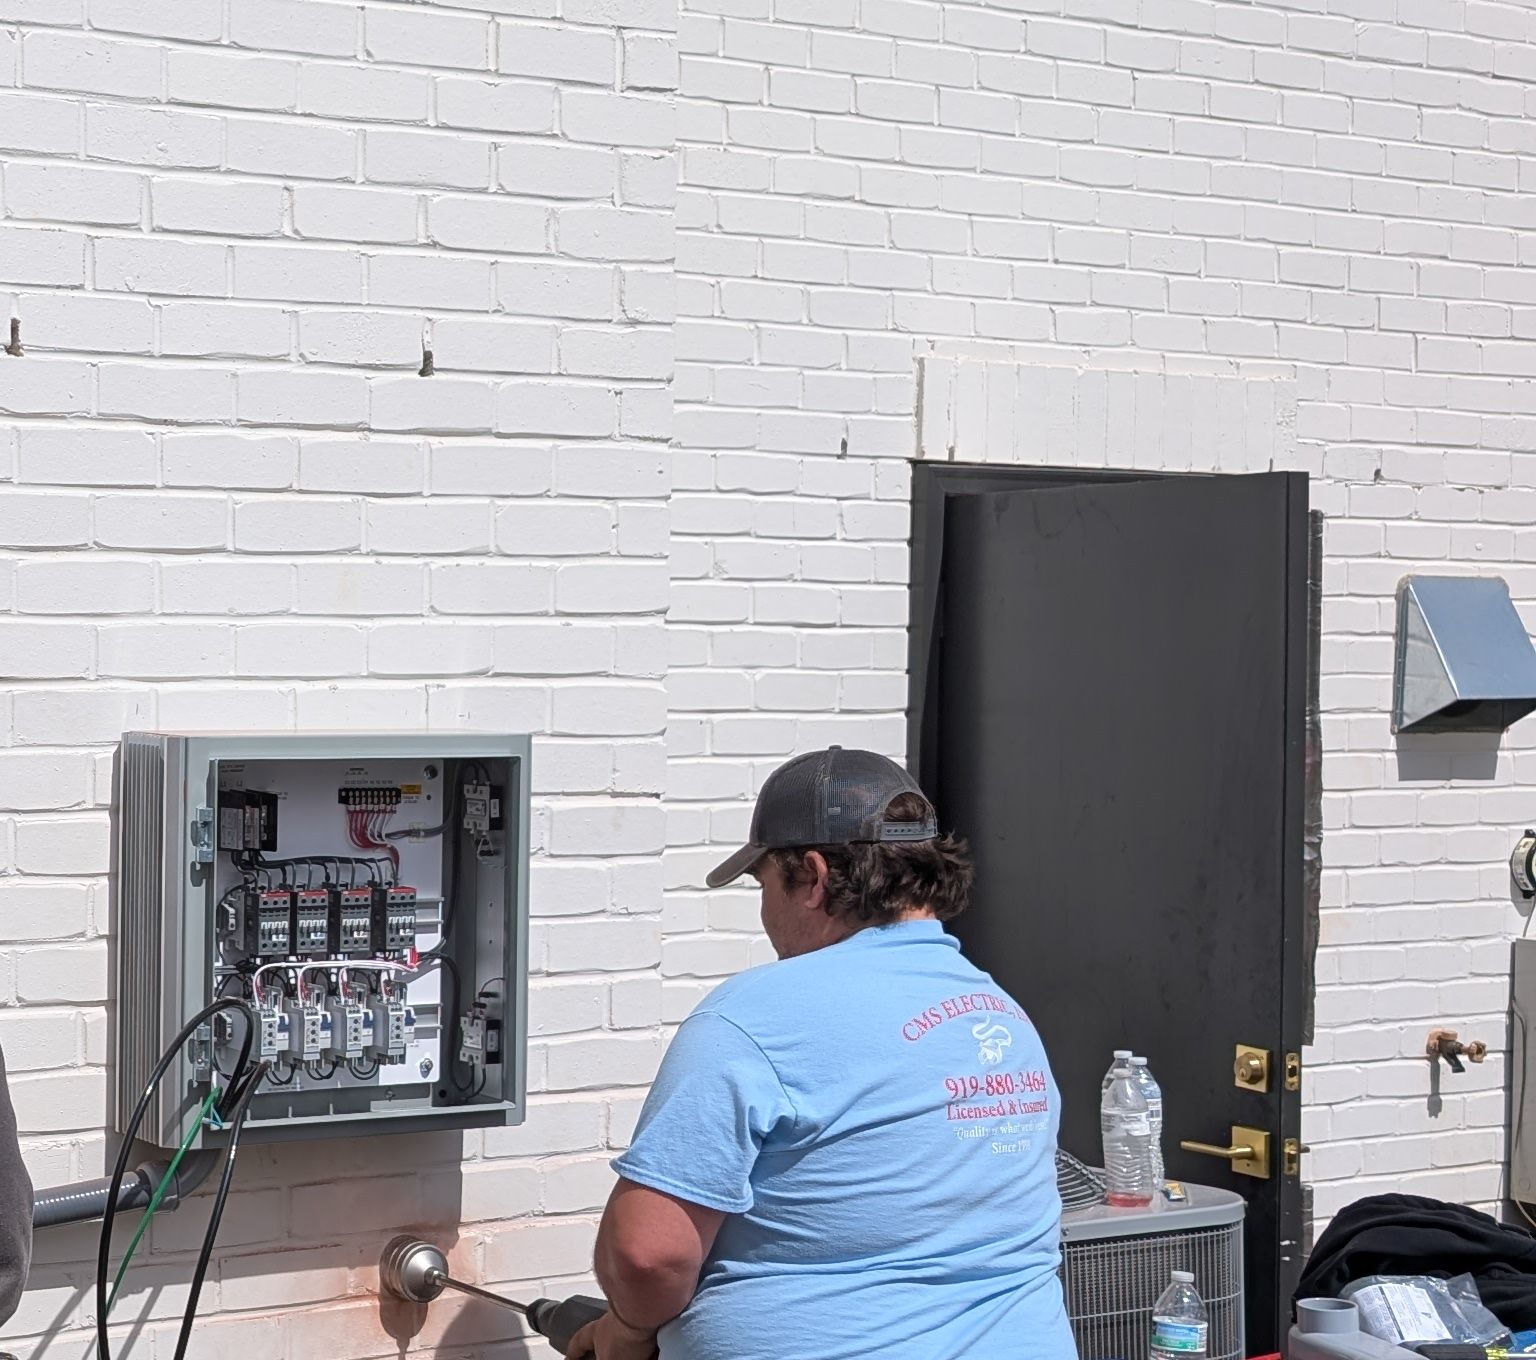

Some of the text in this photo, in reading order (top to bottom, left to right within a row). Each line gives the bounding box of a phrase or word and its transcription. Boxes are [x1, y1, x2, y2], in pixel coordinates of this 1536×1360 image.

[903, 1006, 943, 1041] CMS
[945, 1070, 1047, 1099] 919-880-3464
[946, 1099, 1006, 1121] Licensed
[1008, 1099, 1018, 1115] &
